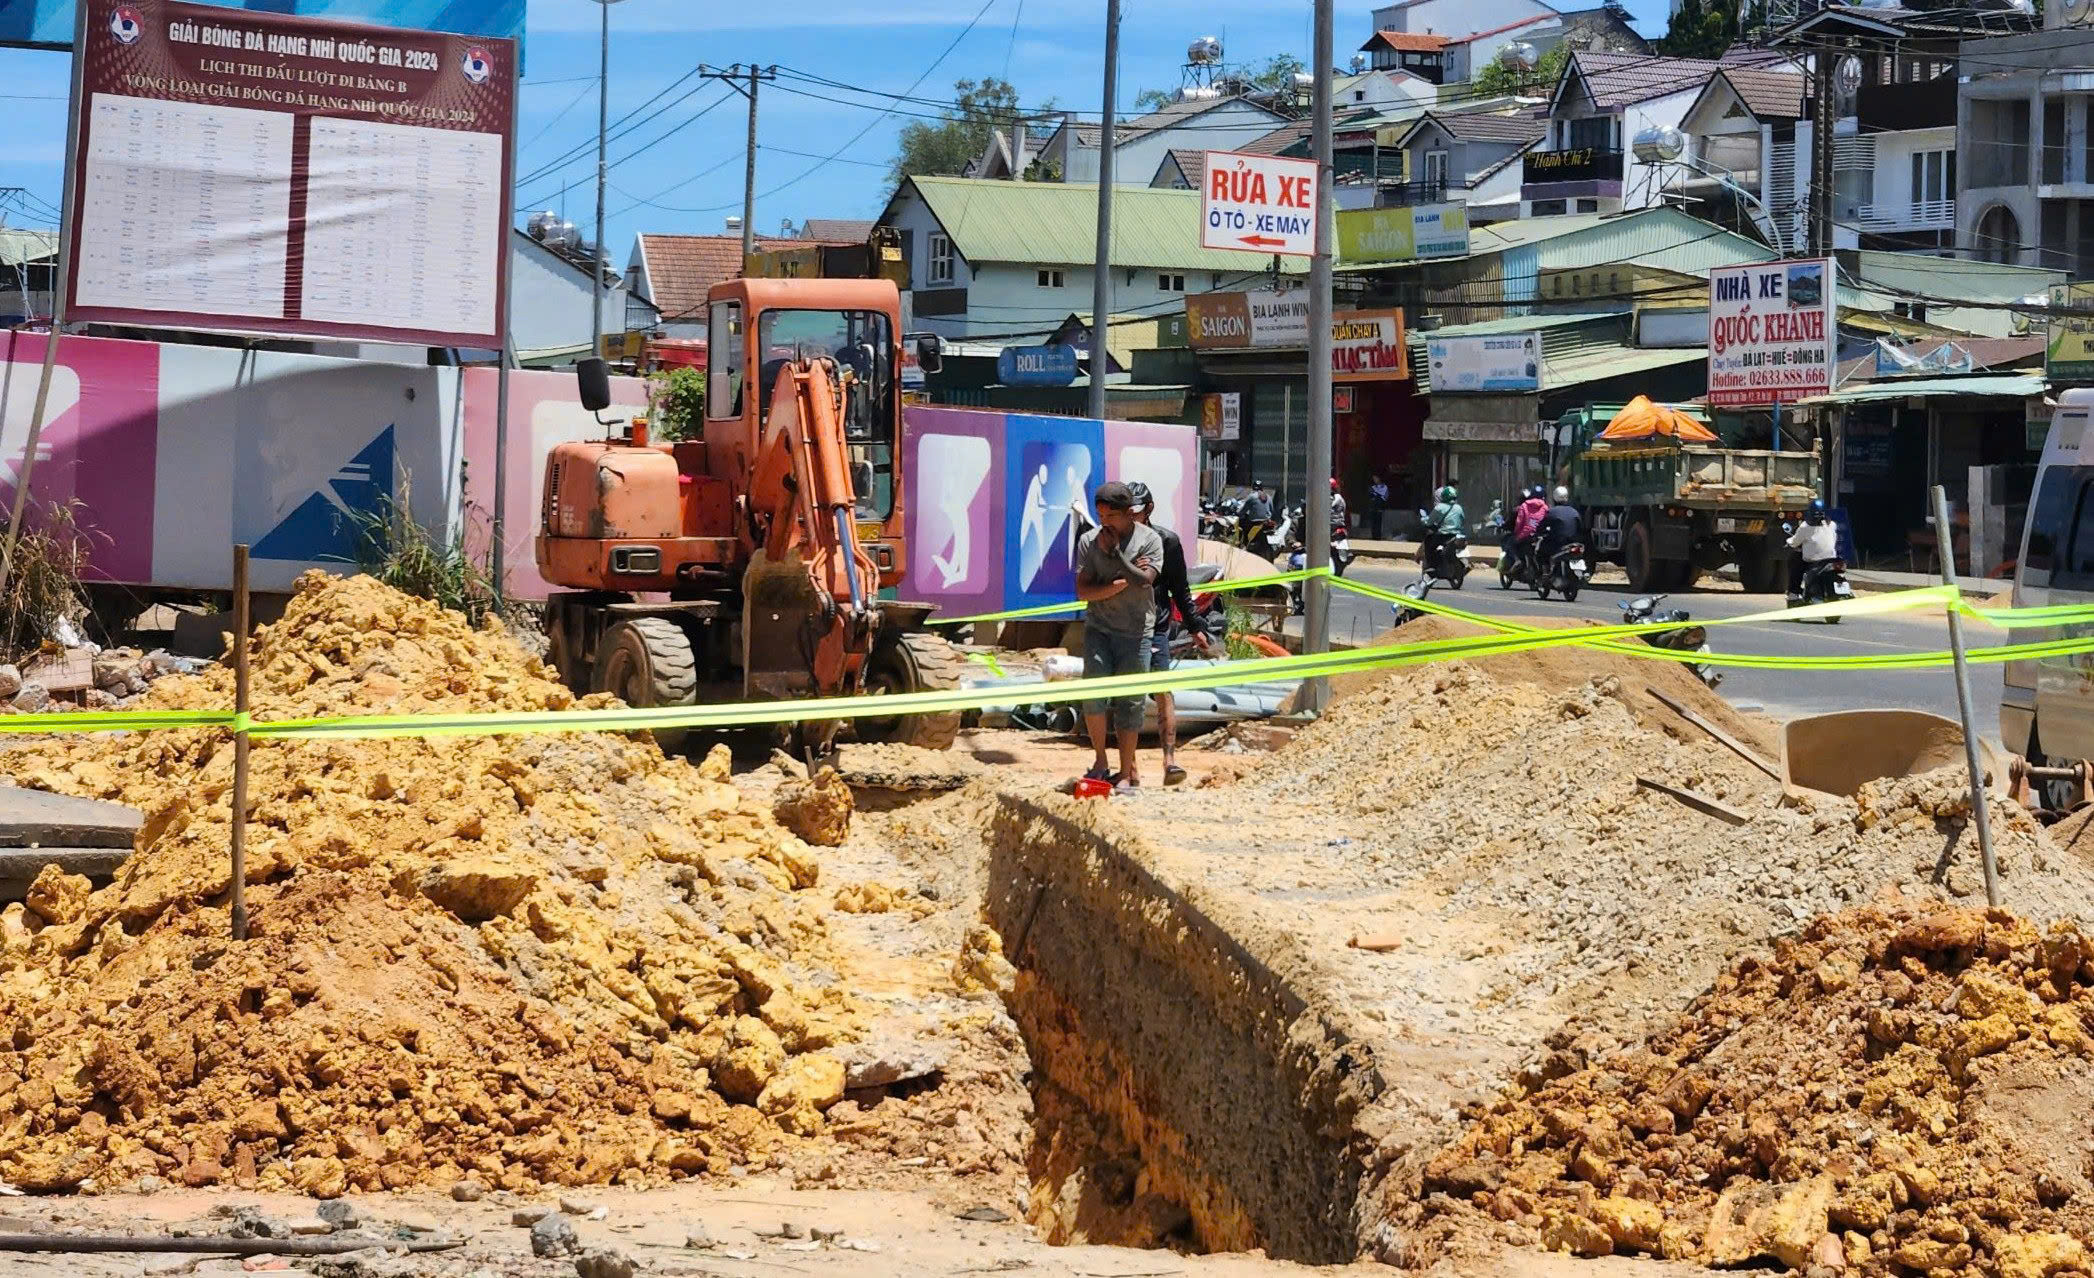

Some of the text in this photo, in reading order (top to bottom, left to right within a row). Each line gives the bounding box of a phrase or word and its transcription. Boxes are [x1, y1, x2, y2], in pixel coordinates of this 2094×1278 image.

[169, 18, 438, 71] GIẢI BÓNG ĐÁ HẠNG NHÌ QUỐC GIA 2024
[200, 58, 407, 93] LỊCH THI ĐẤU LƯỢT ĐI BẢNG B
[125, 73, 476, 123] VÒNG LOẠI GIẢI BÓNG ĐÁ HẠNG NHÌ QUỐC GIA 2024
[1534, 152, 1561, 171] Hạnh
[1584, 147, 1593, 165] 2
[1211, 160, 1311, 209] RỬA XE
[1209, 207, 1221, 228] Ô
[1223, 209, 1245, 230] TÔ
[1255, 214, 1274, 232] XE
[1276, 213, 1311, 235] MÁY
[1716, 270, 1783, 302] NHÀ XE
[1201, 316, 1245, 337] SAIGON
[1253, 304, 1266, 319] BIA
[1268, 303, 1290, 322] LẠNH
[1714, 301, 1825, 356] QUỐC KHÁNH
[1016, 354, 1045, 372] ROLL
[1793, 347, 1813, 364] ĐÔNG
[1712, 372, 1746, 388] Hotline:
